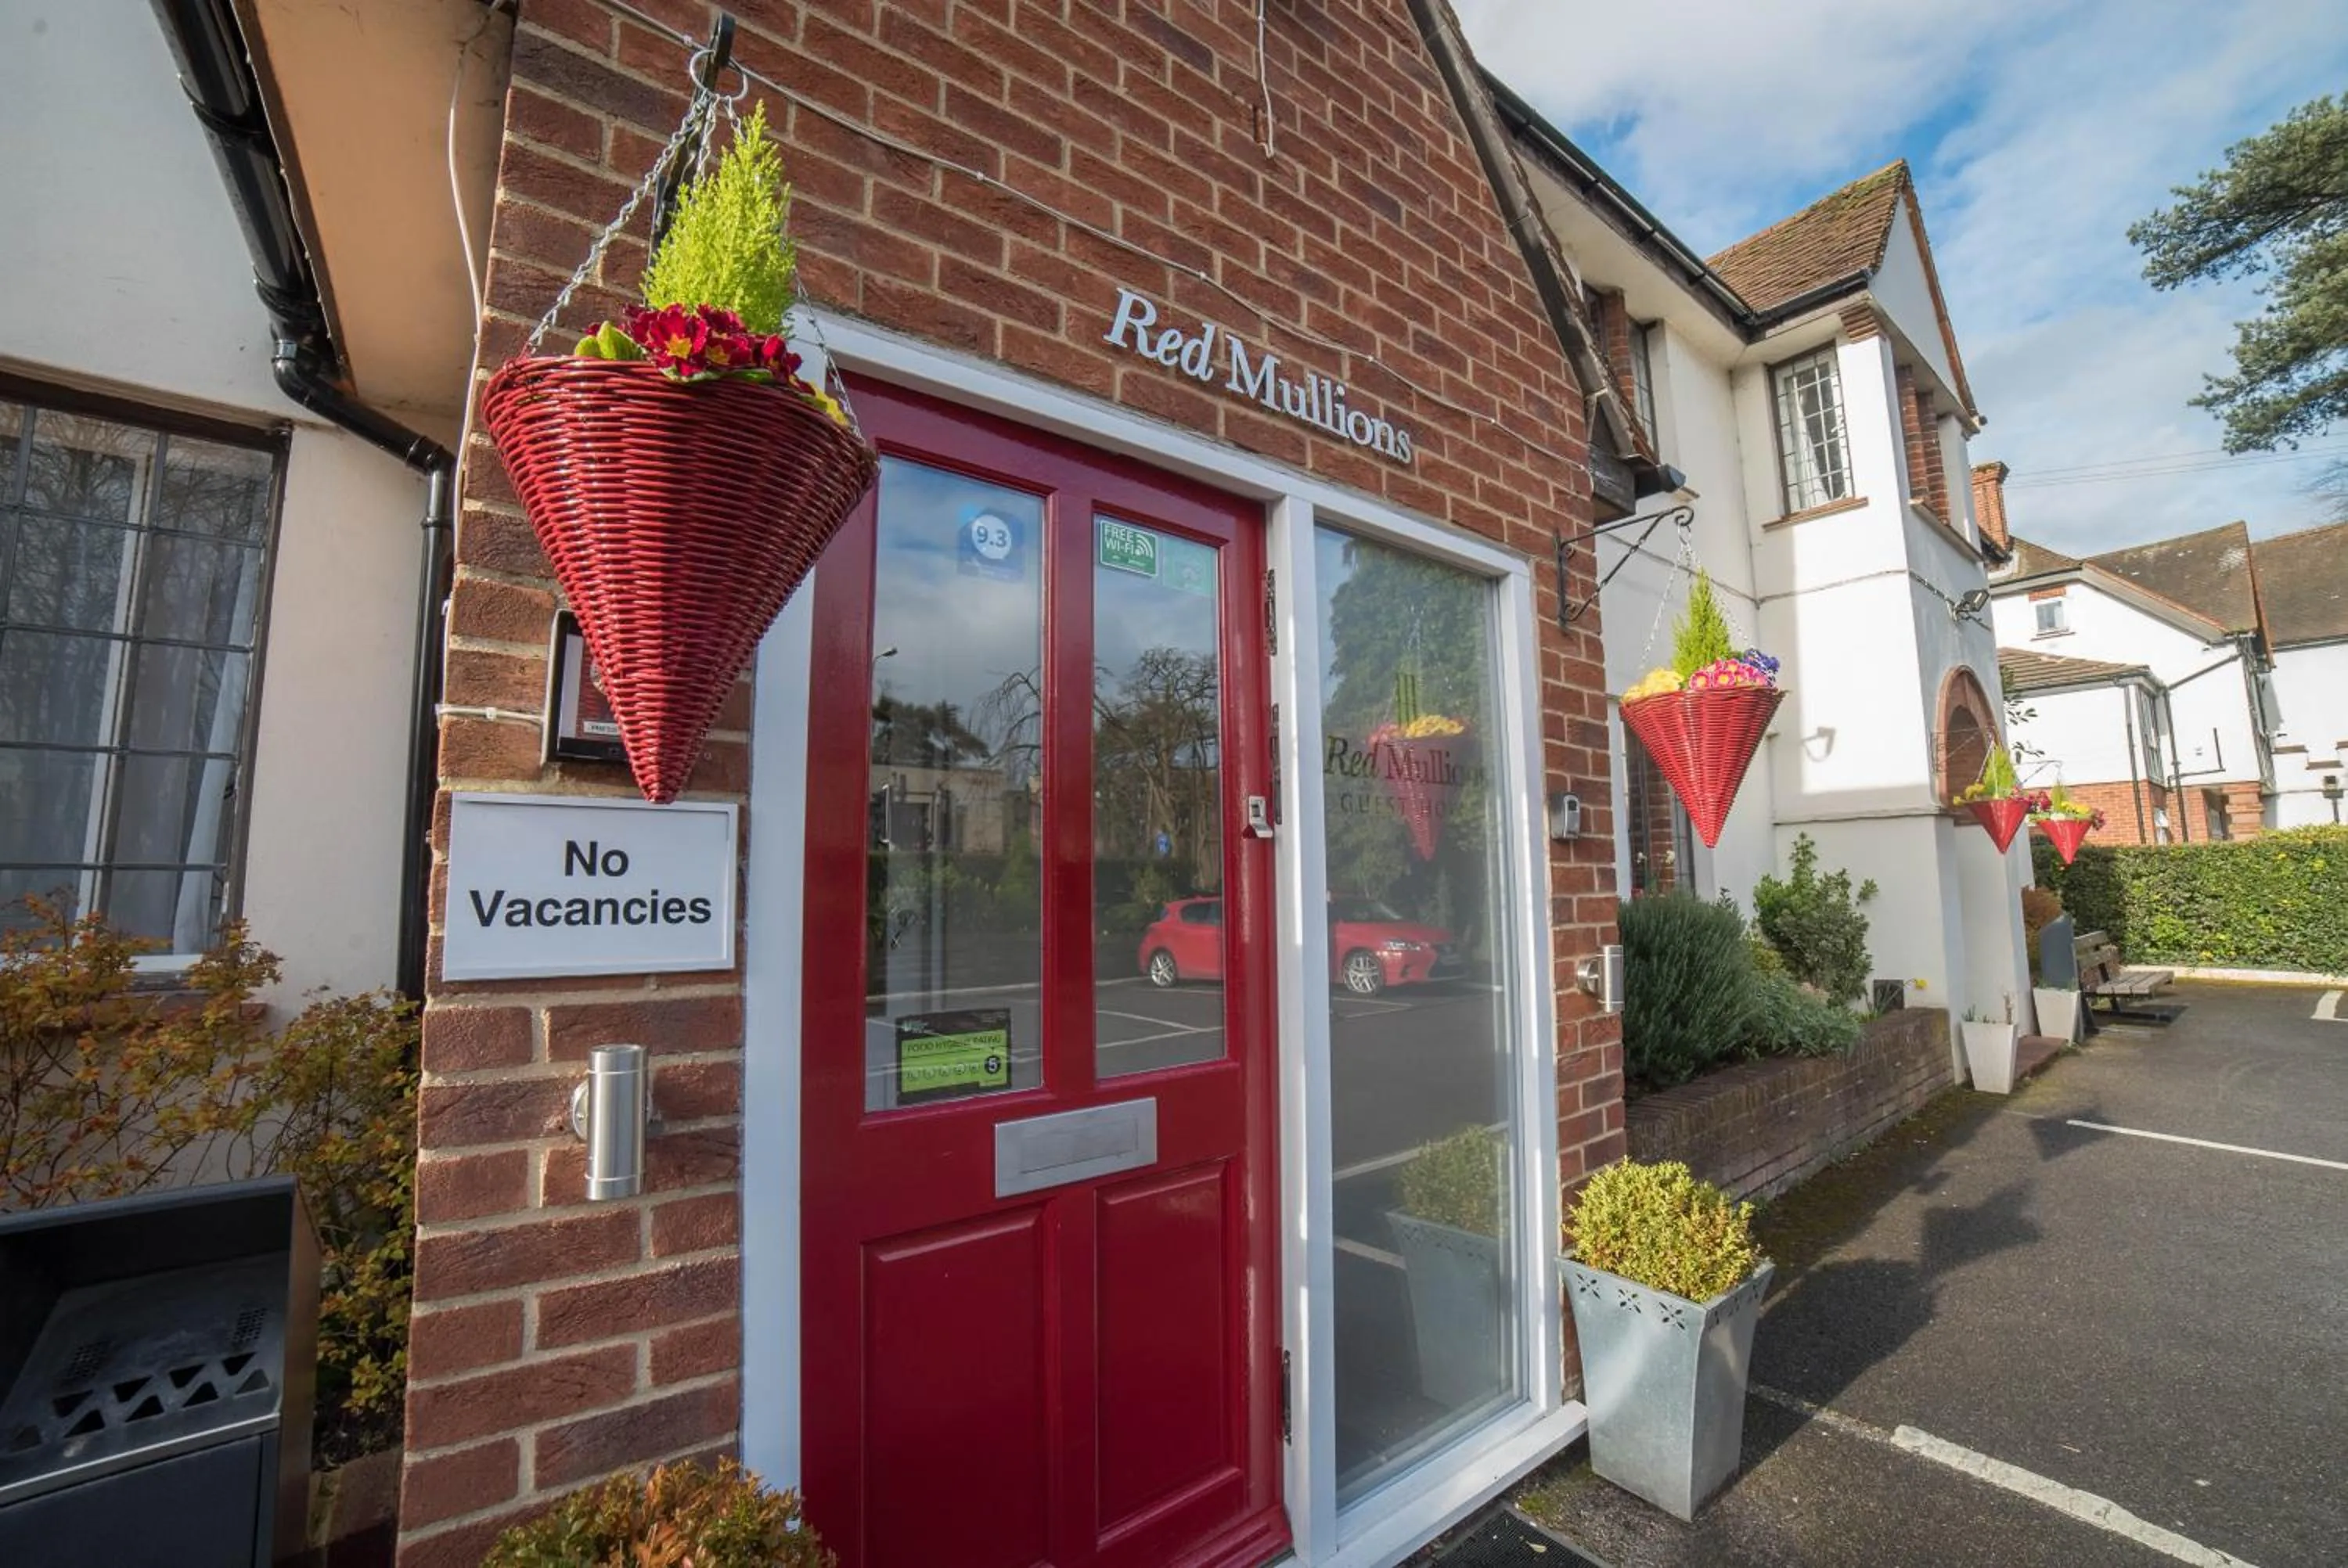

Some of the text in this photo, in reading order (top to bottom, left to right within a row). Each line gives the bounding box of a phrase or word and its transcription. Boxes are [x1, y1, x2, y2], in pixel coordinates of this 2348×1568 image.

[1103, 288, 1411, 464] Red Mullions
[976, 525, 1007, 548] 9.3
[1104, 523, 1134, 544] FREE
[1322, 735, 1485, 786] Red Mullio
[564, 840, 629, 877] No
[470, 889, 712, 927] Vacancies
